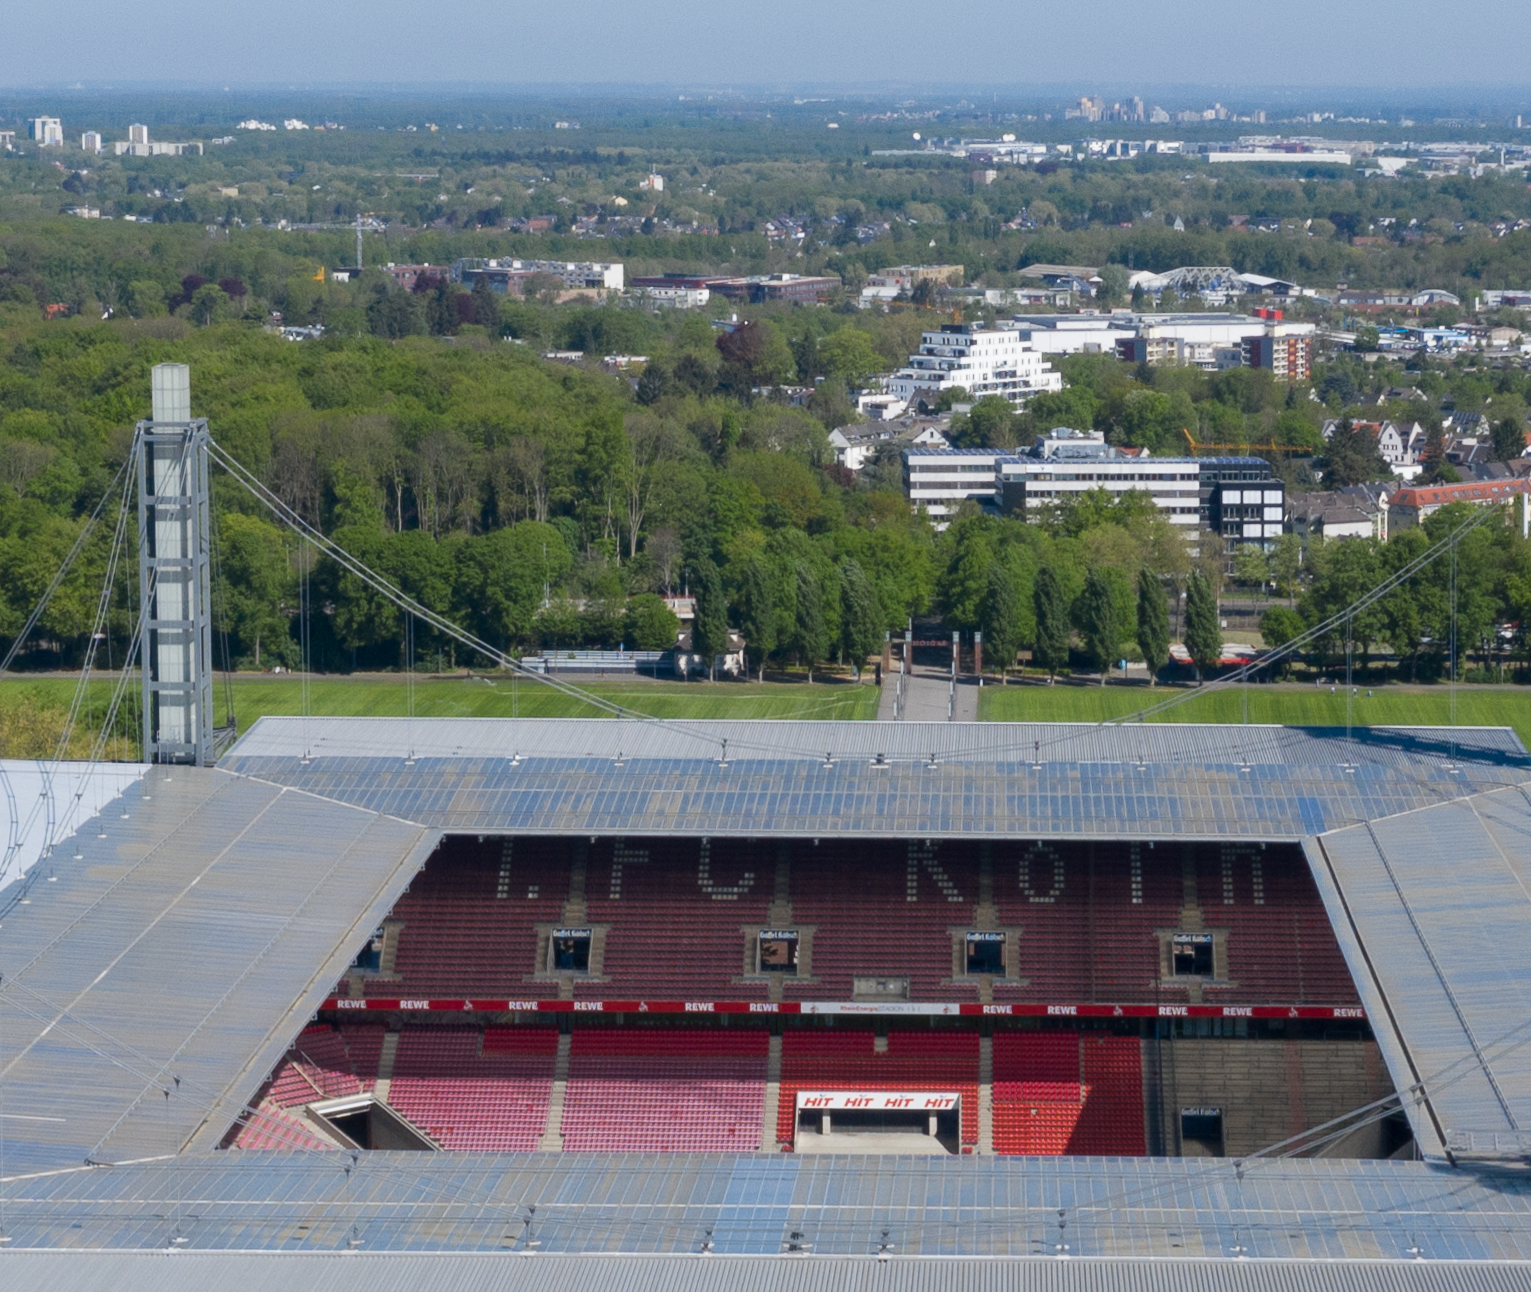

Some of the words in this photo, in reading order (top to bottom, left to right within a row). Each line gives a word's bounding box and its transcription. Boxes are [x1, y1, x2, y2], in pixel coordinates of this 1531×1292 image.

[338, 1000, 366, 1008] REWE
[400, 1000, 429, 1009] REWE
[509, 1001, 538, 1010] REWE
[574, 1001, 603, 1010] REWE
[685, 1002, 714, 1011] REWE
[750, 1003, 779, 1012] REWE
[983, 1005, 1012, 1014] REWE
[1048, 1006, 1076, 1014] REWE
[1159, 1007, 1188, 1015] REWE
[1223, 1007, 1252, 1015] REWE
[1334, 1008, 1363, 1016] REWE
[804, 1097, 833, 1106] HIT
[844, 1097, 873, 1106] HIT
[884, 1098, 913, 1107] HIT
[924, 1098, 953, 1107] HIT
